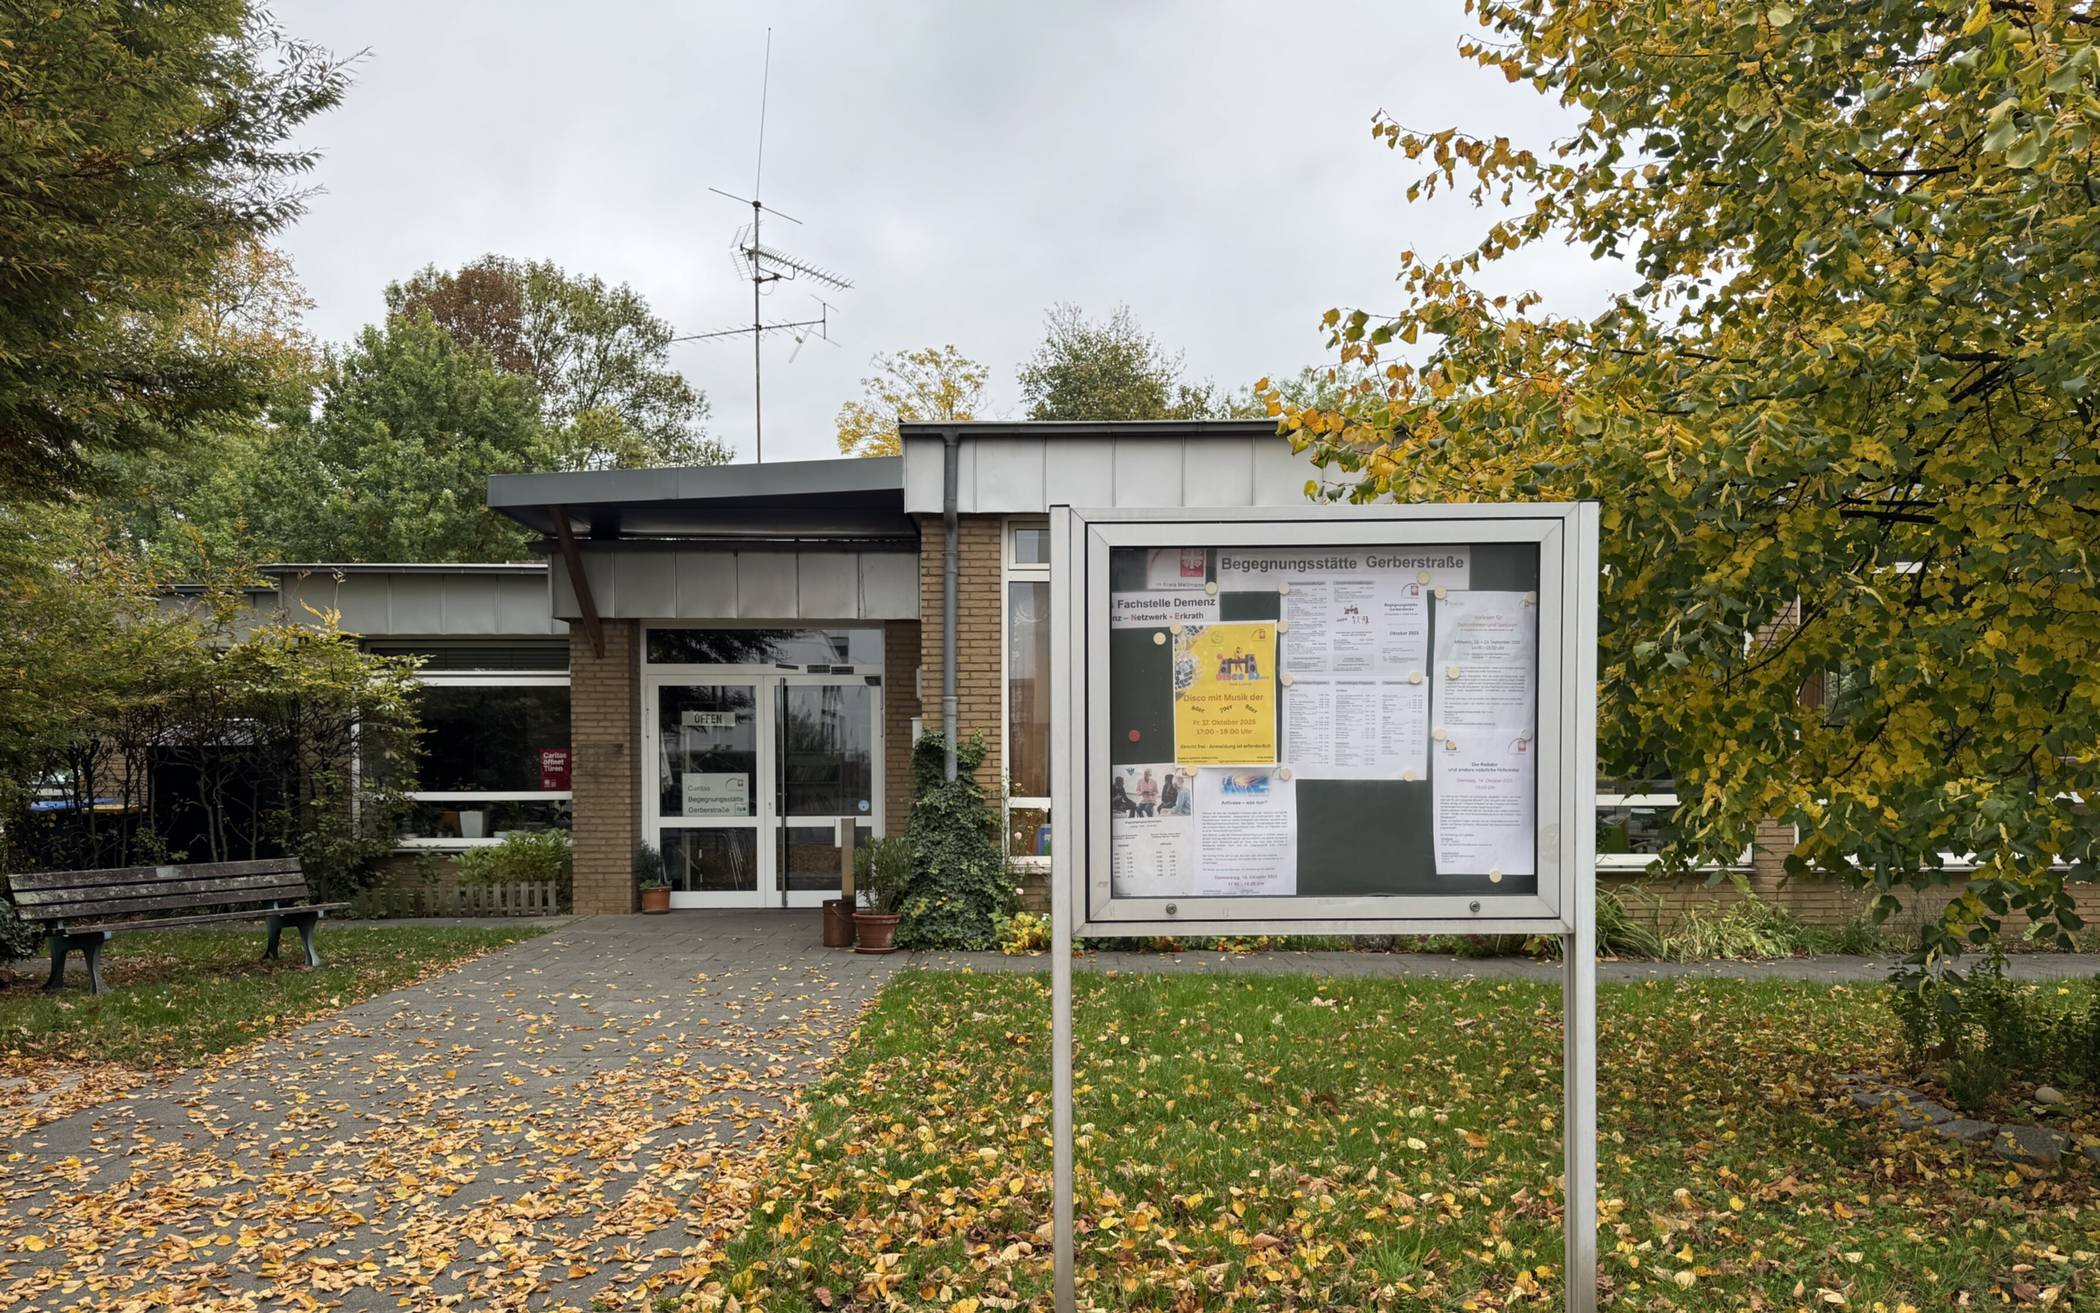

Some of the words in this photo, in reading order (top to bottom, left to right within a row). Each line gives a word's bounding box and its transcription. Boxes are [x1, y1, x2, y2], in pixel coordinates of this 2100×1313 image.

[1221, 557, 1357, 572] Begegnungsstätte
[1366, 555, 1464, 569] Gerberstraße
[1117, 599, 1171, 609] Fachstelle
[1174, 597, 1216, 608] Demenz
[1131, 614, 1168, 622] Netzwerk
[1174, 612, 1204, 620] Erkrath
[1183, 694, 1206, 702] Disco
[1249, 693, 1264, 701] der
[694, 713, 723, 725] OFFEN
[543, 751, 567, 759] Caritas
[543, 758, 564, 766] öffnet
[687, 796, 745, 804] Begegnungsstätte
[687, 806, 731, 814] Gerberstraße
